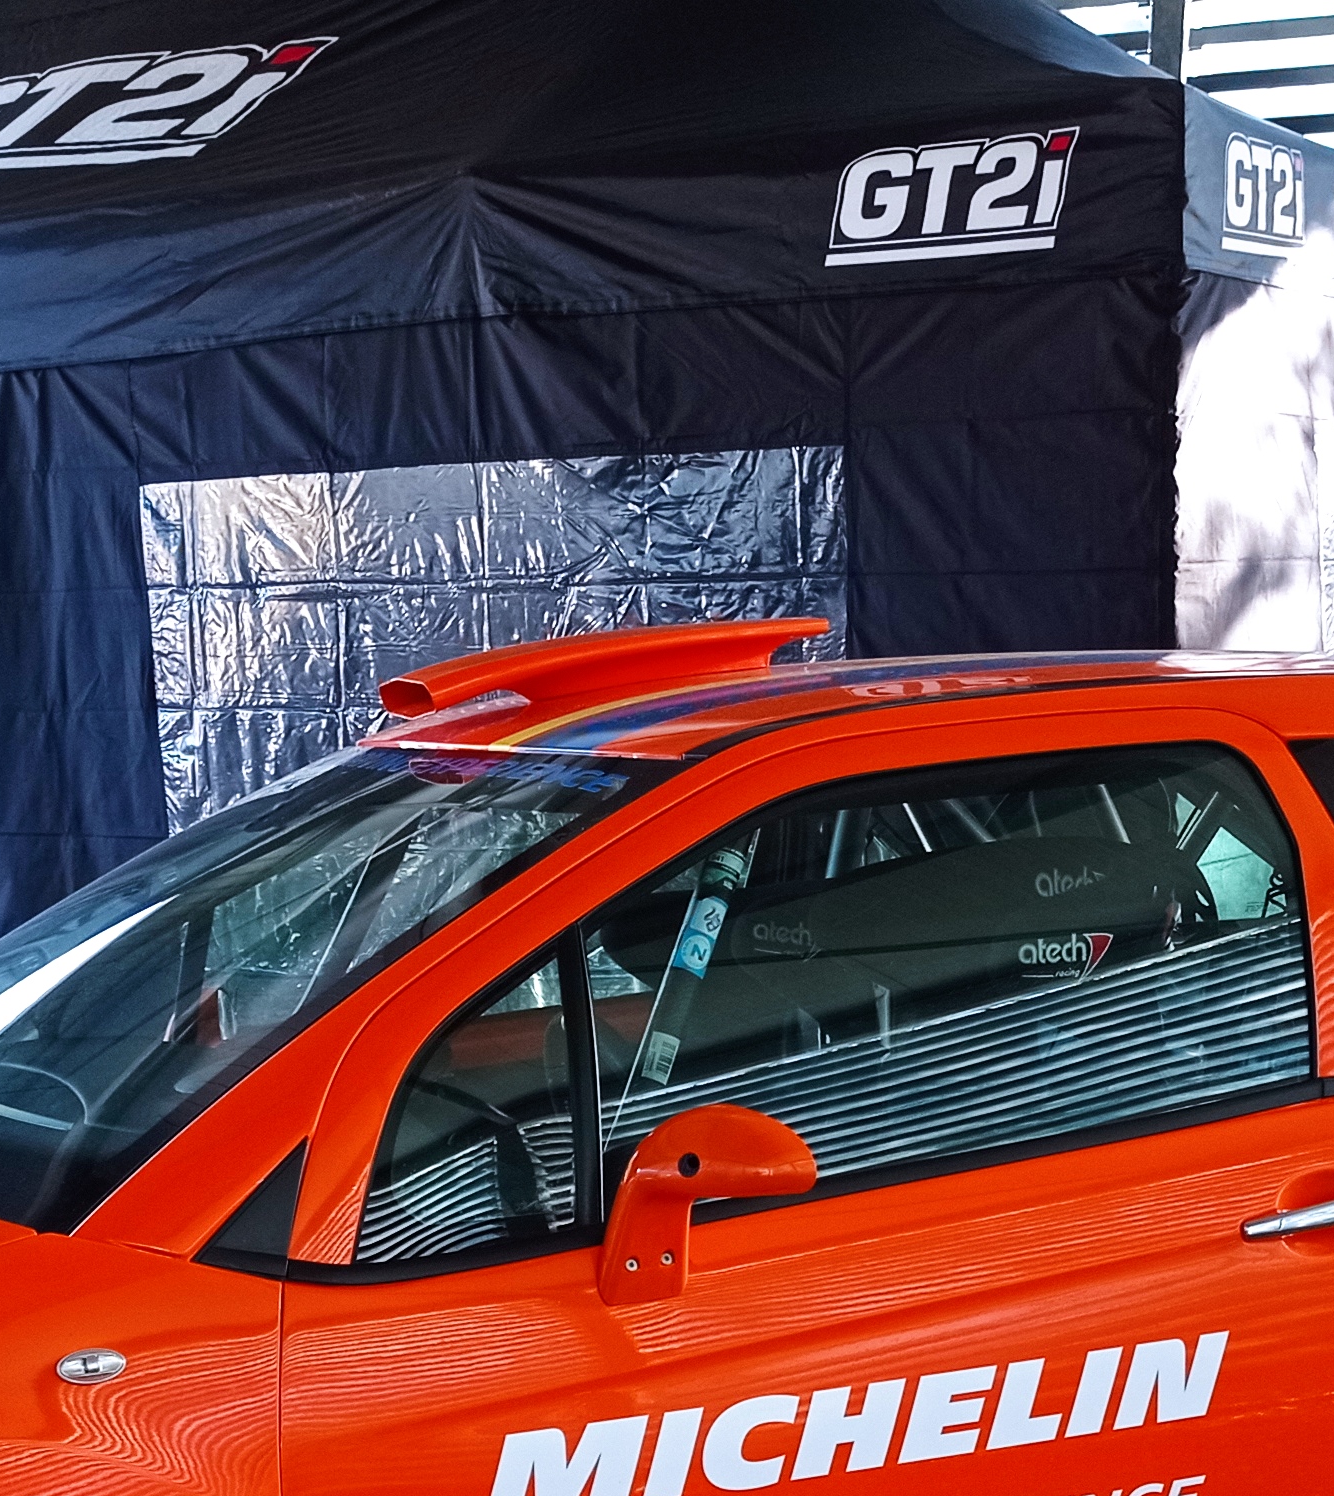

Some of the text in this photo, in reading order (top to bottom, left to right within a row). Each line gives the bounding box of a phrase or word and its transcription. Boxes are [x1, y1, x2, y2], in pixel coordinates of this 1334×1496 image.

[839, 134, 1072, 240] GT2i
[1226, 138, 1303, 237] GT2i
[1018, 933, 1087, 965] atech
[1055, 967, 1081, 978] racing
